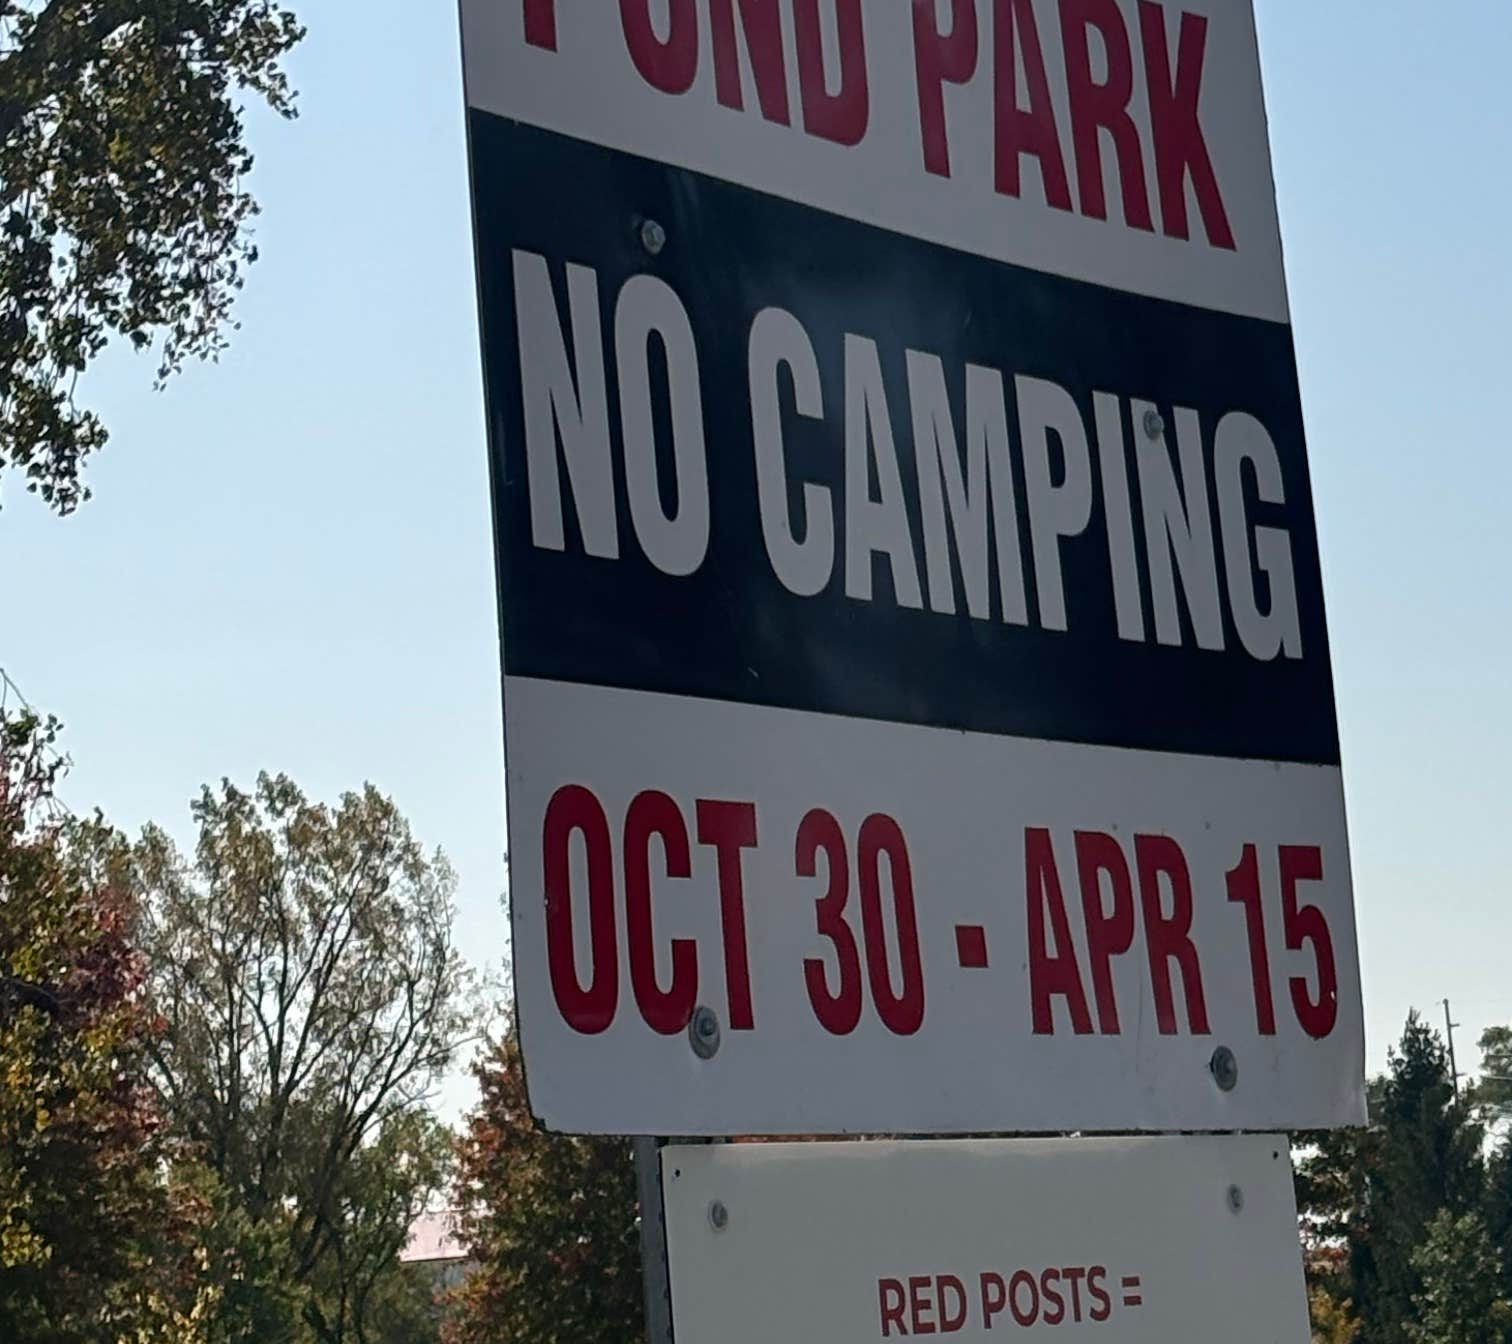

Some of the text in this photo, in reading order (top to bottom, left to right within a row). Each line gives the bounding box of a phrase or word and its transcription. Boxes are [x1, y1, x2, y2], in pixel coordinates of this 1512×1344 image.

[512, 248, 1302, 661] NO CAMPING
[543, 784, 1338, 1039] OCT 30 - APR 15
[878, 1265, 1142, 1336] RED POSTS =
